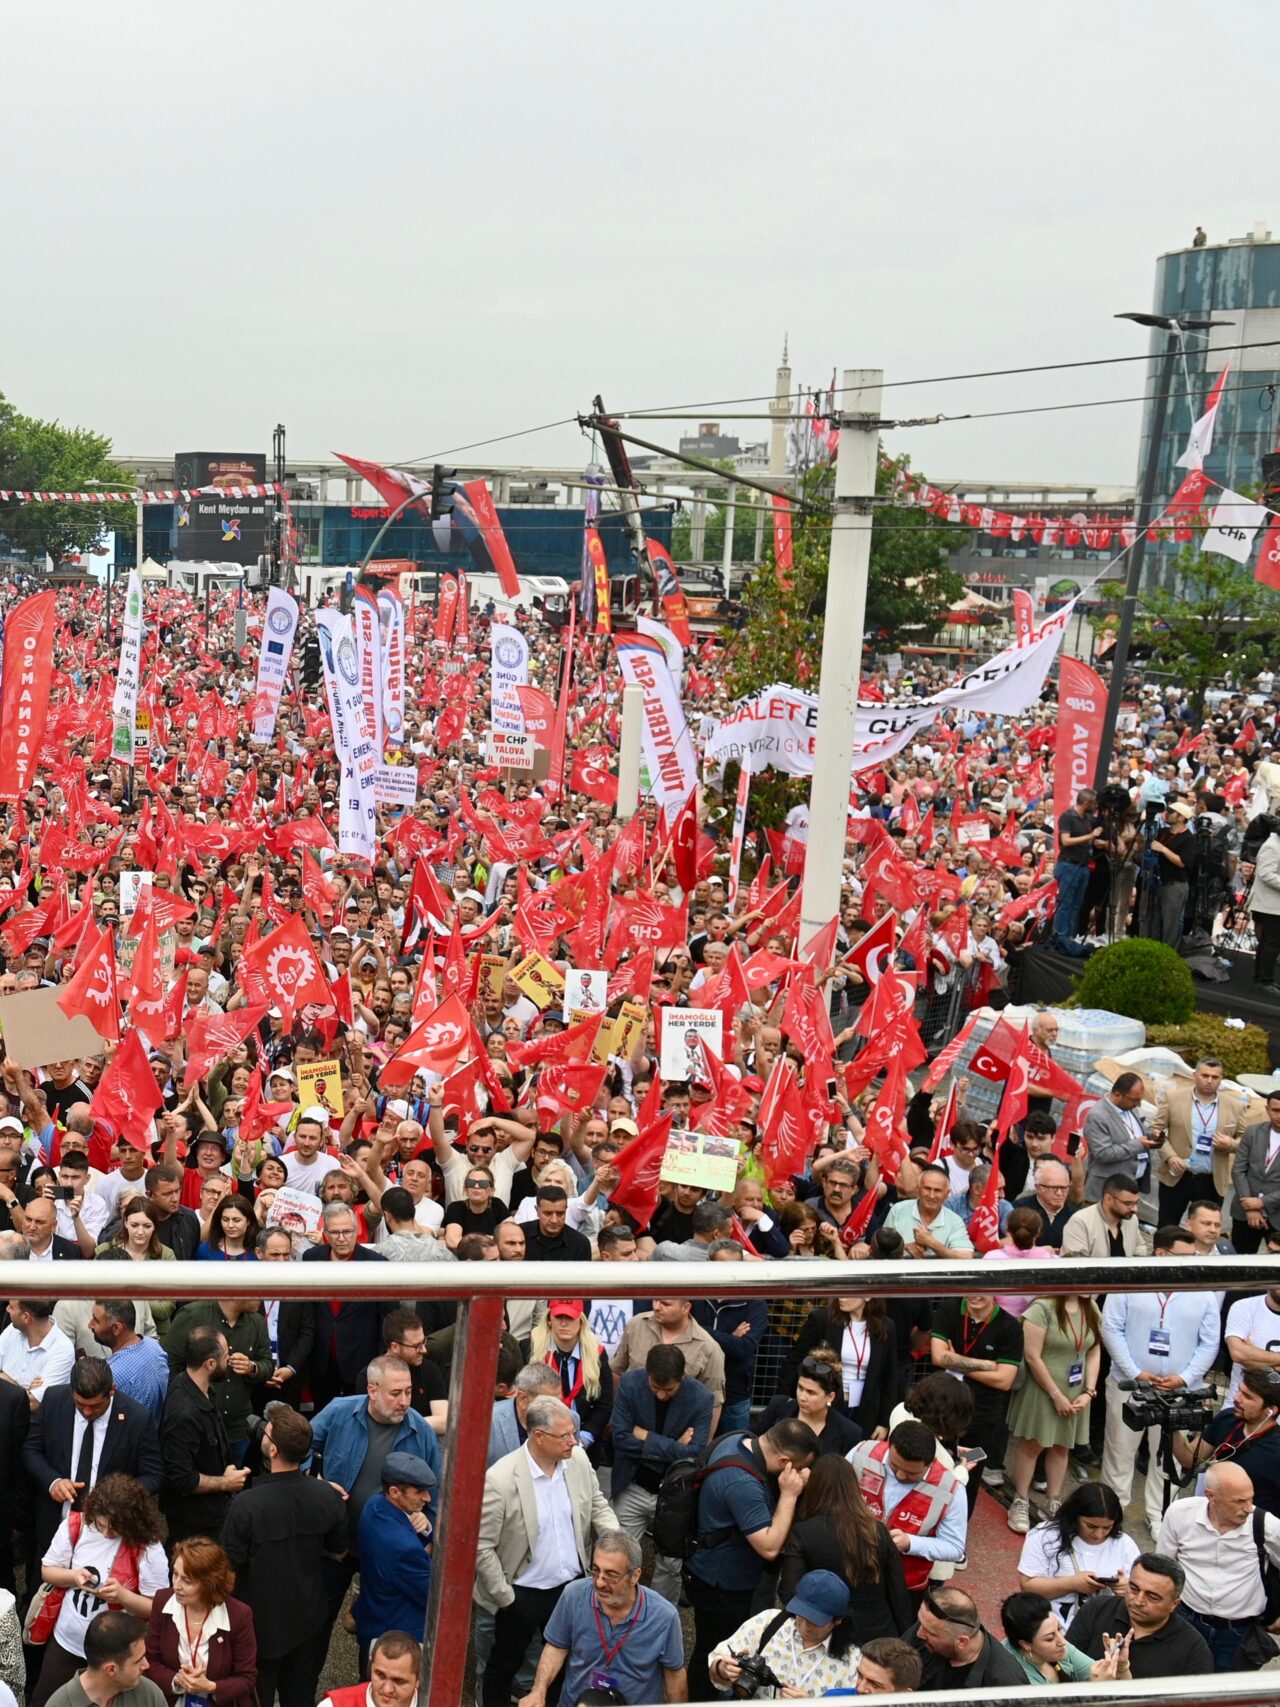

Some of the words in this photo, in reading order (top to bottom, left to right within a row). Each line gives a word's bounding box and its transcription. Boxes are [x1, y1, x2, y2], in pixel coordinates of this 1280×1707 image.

[199, 504, 216, 514] Kent
[218, 504, 250, 516] Meydanı
[251, 506, 265, 514] AVM
[1218, 524, 1247, 542] CHP
[720, 698, 802, 730] ADALET
[506, 736, 528, 744] CHP
[494, 746, 525, 756] YALOVA
[487, 755, 495, 764] İL
[499, 756, 531, 767] ÖRGÜTÜ
[513, 952, 539, 977] İMAMOĞLU
[668, 1012, 717, 1021] İMAMOĞLU
[300, 1064, 337, 1075] İMAMOĞLU
[300, 1073, 315, 1081] HER
[315, 1069, 338, 1079] YERDE
